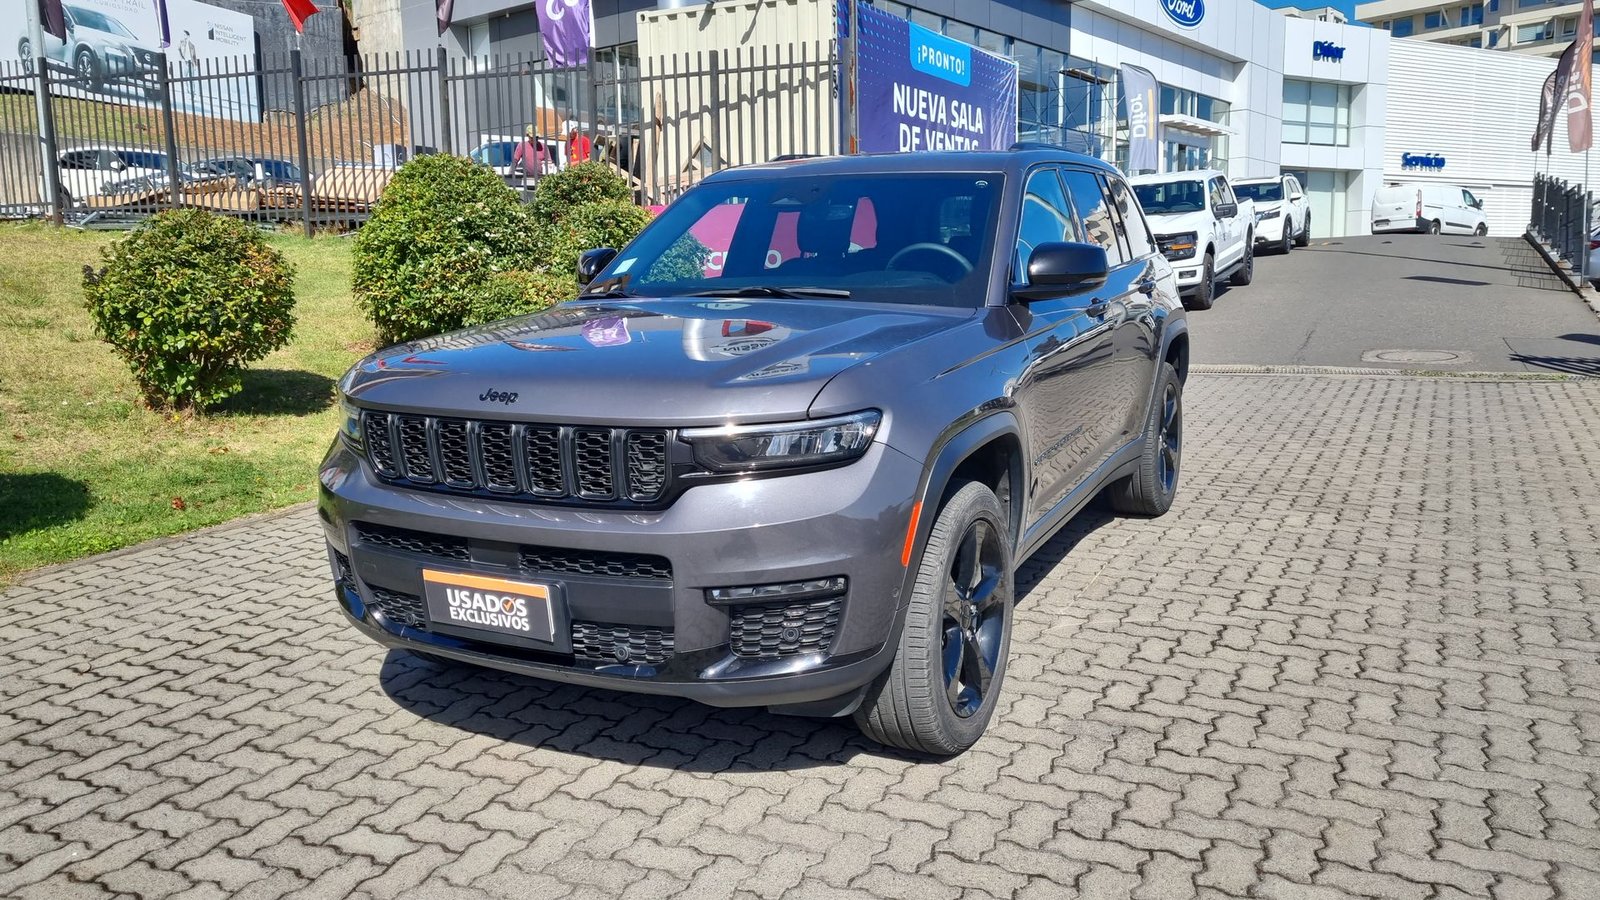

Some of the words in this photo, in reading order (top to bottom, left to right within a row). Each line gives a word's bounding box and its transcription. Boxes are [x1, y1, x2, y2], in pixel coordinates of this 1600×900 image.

[917, 44, 965, 76] ¡PRONTO!
[893, 81, 947, 126] NUEVA
[950, 100, 984, 134] SALA
[479, 387, 519, 405] Jeep
[446, 588, 528, 617] USADOS
[449, 606, 531, 632] EXCLUSIVOS
